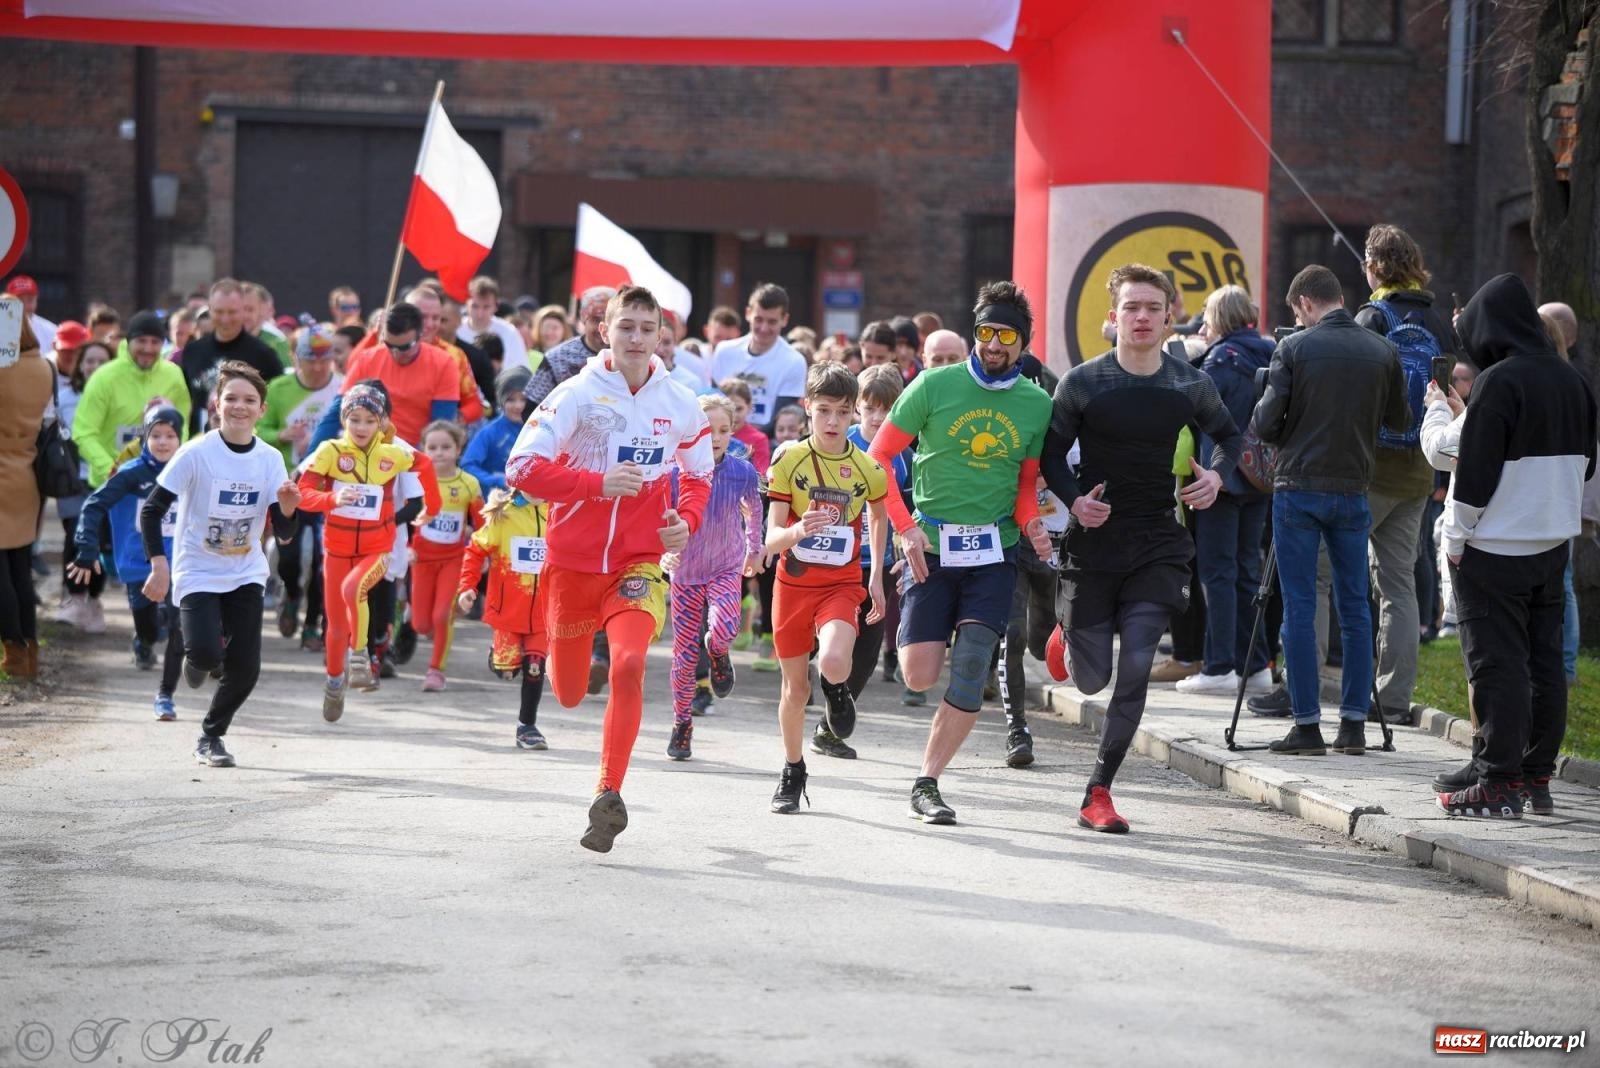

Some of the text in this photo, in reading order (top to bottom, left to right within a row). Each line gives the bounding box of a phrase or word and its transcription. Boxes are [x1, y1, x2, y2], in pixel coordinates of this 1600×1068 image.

[947, 409, 993, 437] NADMORSKA
[633, 449, 655, 464] 67
[231, 493, 249, 505] 44
[434, 520, 456, 533] 100
[811, 537, 832, 550] 29
[961, 535, 980, 551] 56
[529, 548, 546, 561] 68
